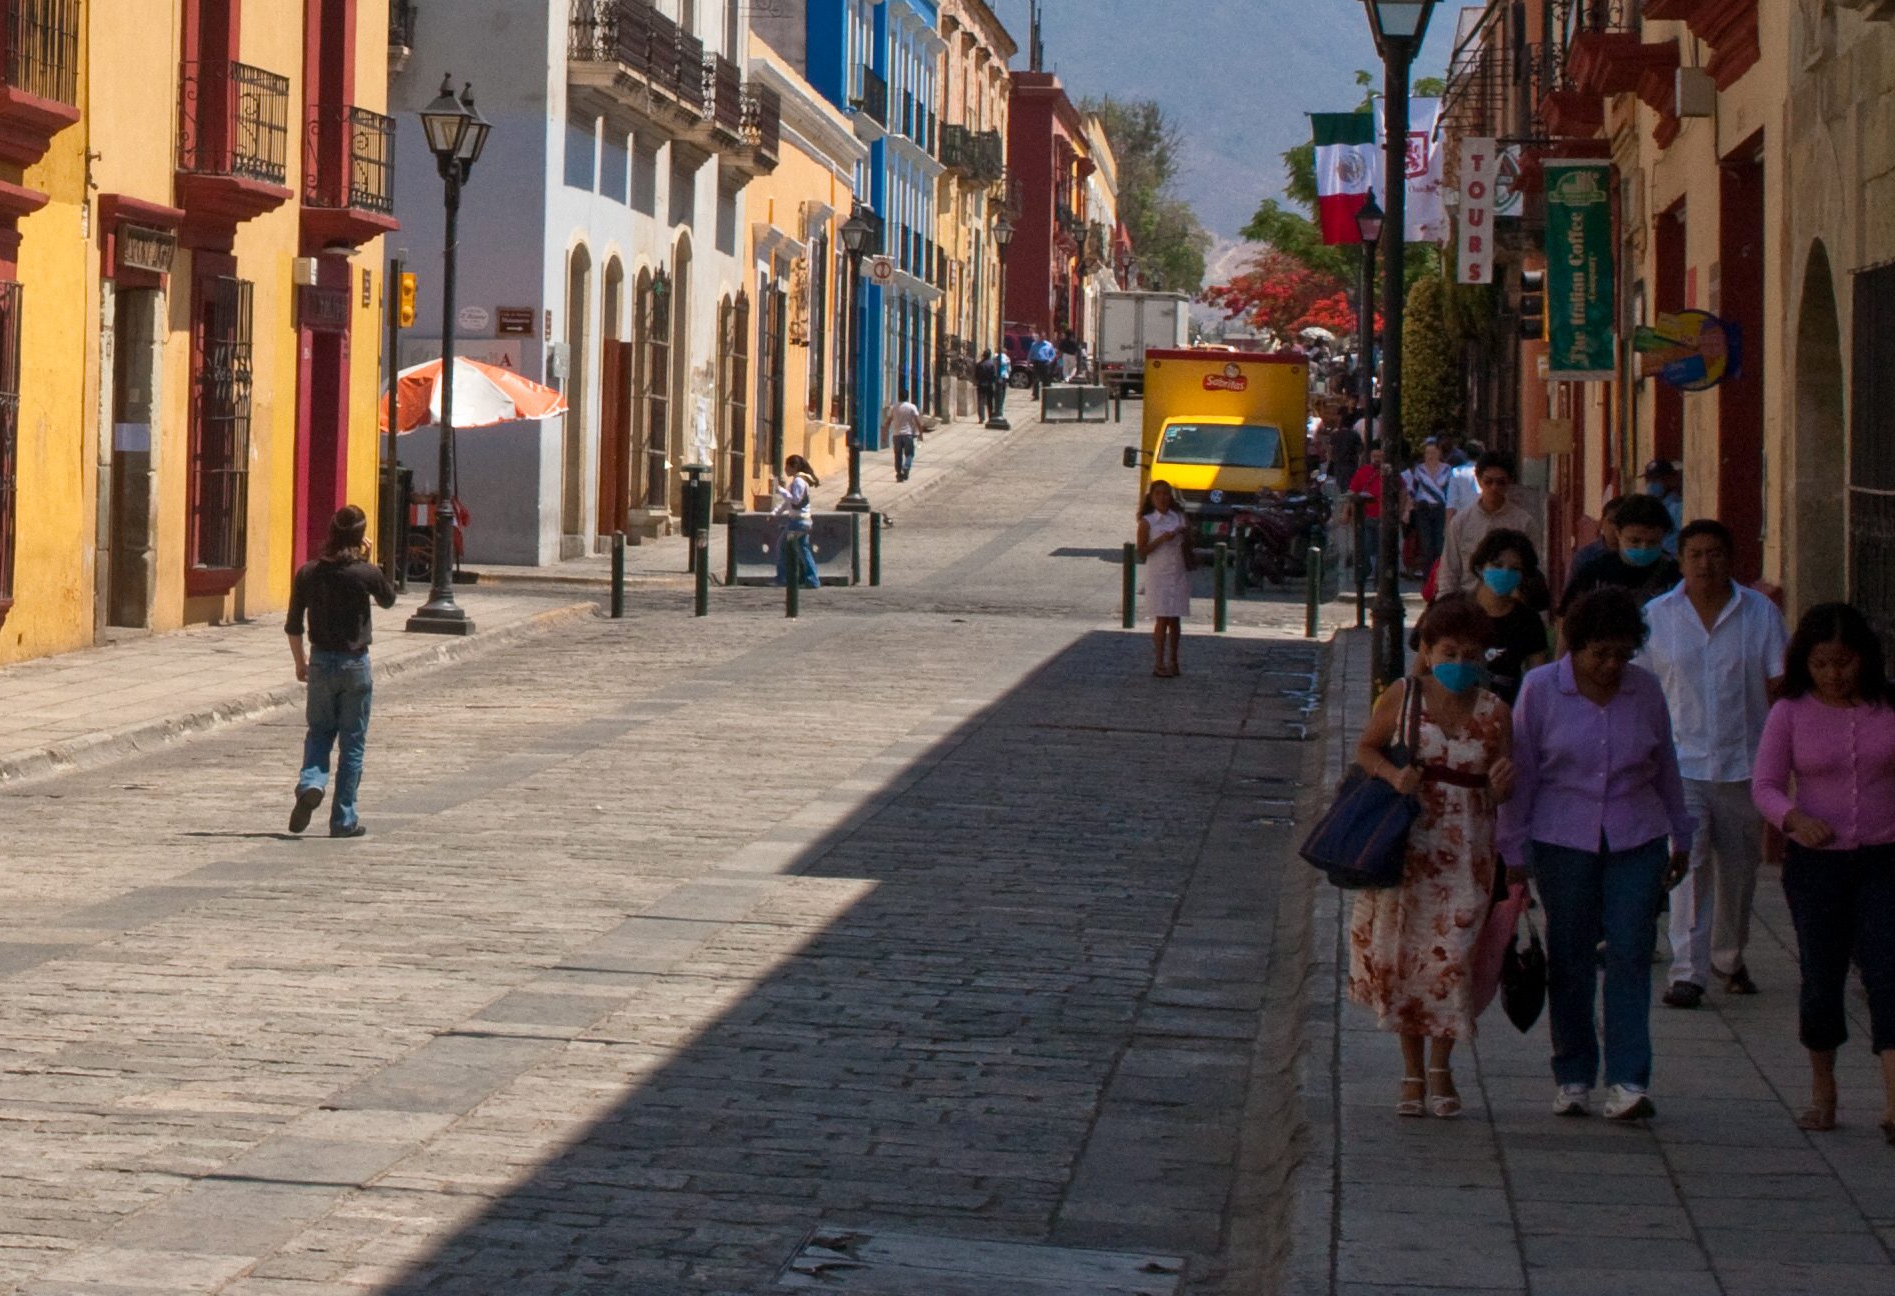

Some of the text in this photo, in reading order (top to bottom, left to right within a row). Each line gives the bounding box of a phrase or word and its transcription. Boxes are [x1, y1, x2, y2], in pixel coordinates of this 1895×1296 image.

[1467, 154, 1486, 281] TOURS
[1568, 212, 1585, 267] Coffee
[1569, 271, 1586, 326] Italian
[1206, 375, 1245, 390] Sabritas
